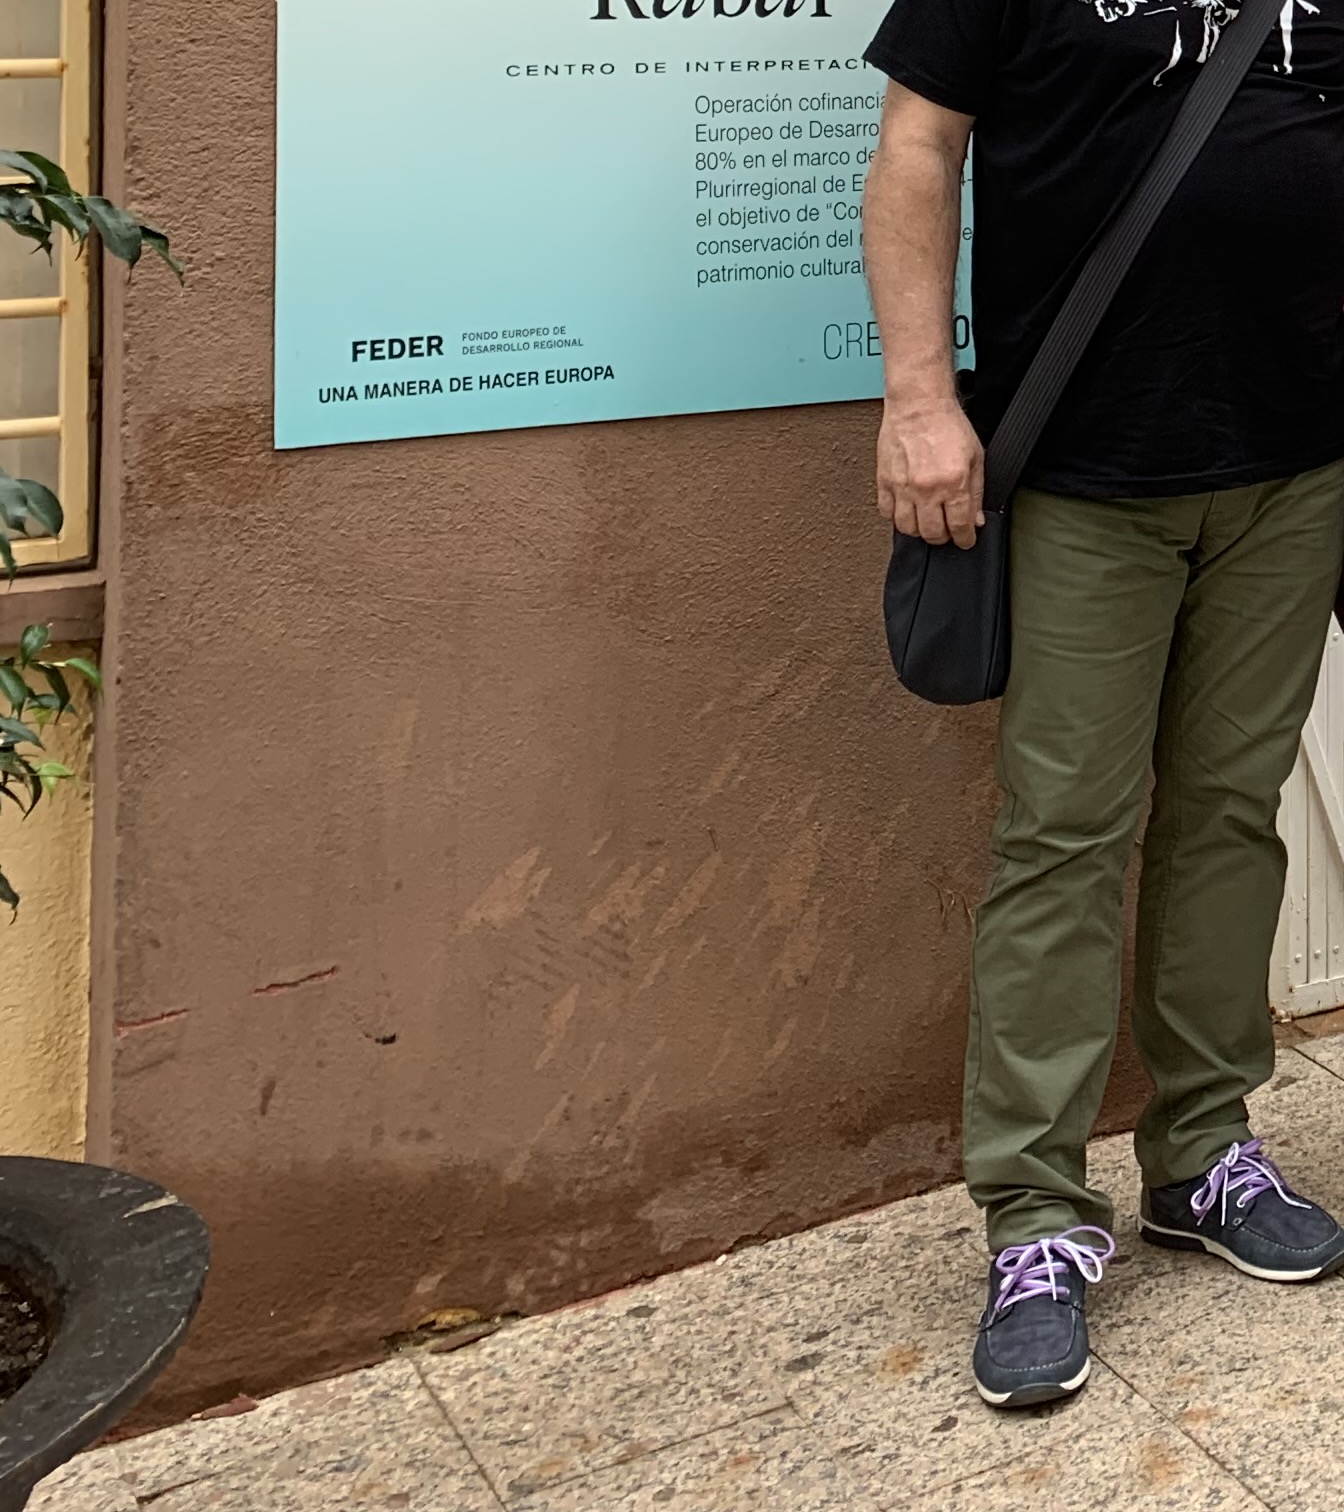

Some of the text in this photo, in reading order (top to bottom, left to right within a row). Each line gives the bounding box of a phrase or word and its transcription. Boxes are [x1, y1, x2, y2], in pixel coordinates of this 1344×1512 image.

[505, 58, 867, 77] CENTRO DE INTERPRETACI
[695, 93, 791, 118] Operación
[695, 120, 880, 145] Europeo de Desarro
[695, 151, 737, 171] 80%
[743, 154, 765, 168] en
[772, 149, 788, 167] el
[793, 149, 850, 167] marco
[695, 176, 816, 201] Plurirregional
[822, 175, 846, 193] de
[696, 208, 712, 227] el
[717, 206, 791, 230] objetivo
[796, 204, 820, 223] de
[696, 233, 819, 256] conservación
[826, 230, 853, 248] del
[697, 256, 865, 288] patrimonio cultural
[351, 326, 566, 363] FEDER FONDO EUROPEO DE
[462, 337, 583, 355] DESARROLLO REGIONAL
[319, 365, 615, 404] UNA MANERA DE HACER EUROPA
